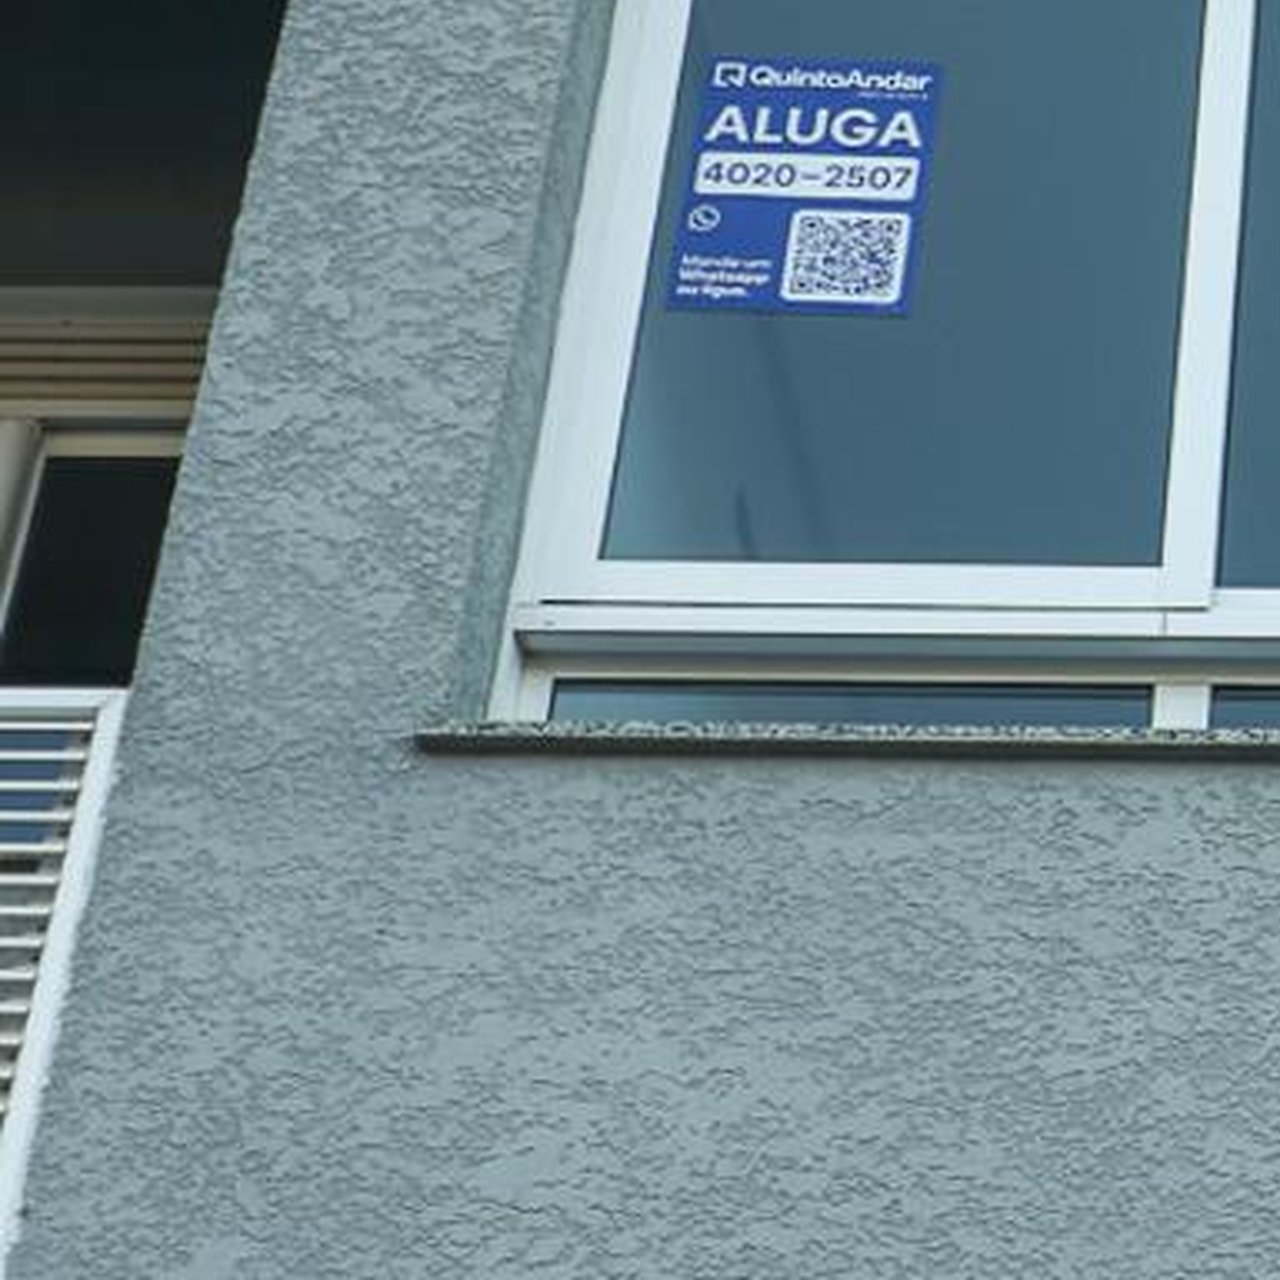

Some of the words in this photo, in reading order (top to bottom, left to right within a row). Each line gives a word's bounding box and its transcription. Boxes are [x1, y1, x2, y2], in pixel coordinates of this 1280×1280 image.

[750, 64, 932, 91] QuintoAndar
[703, 104, 922, 148] ALUGA
[702, 162, 913, 191] 4020-2507
